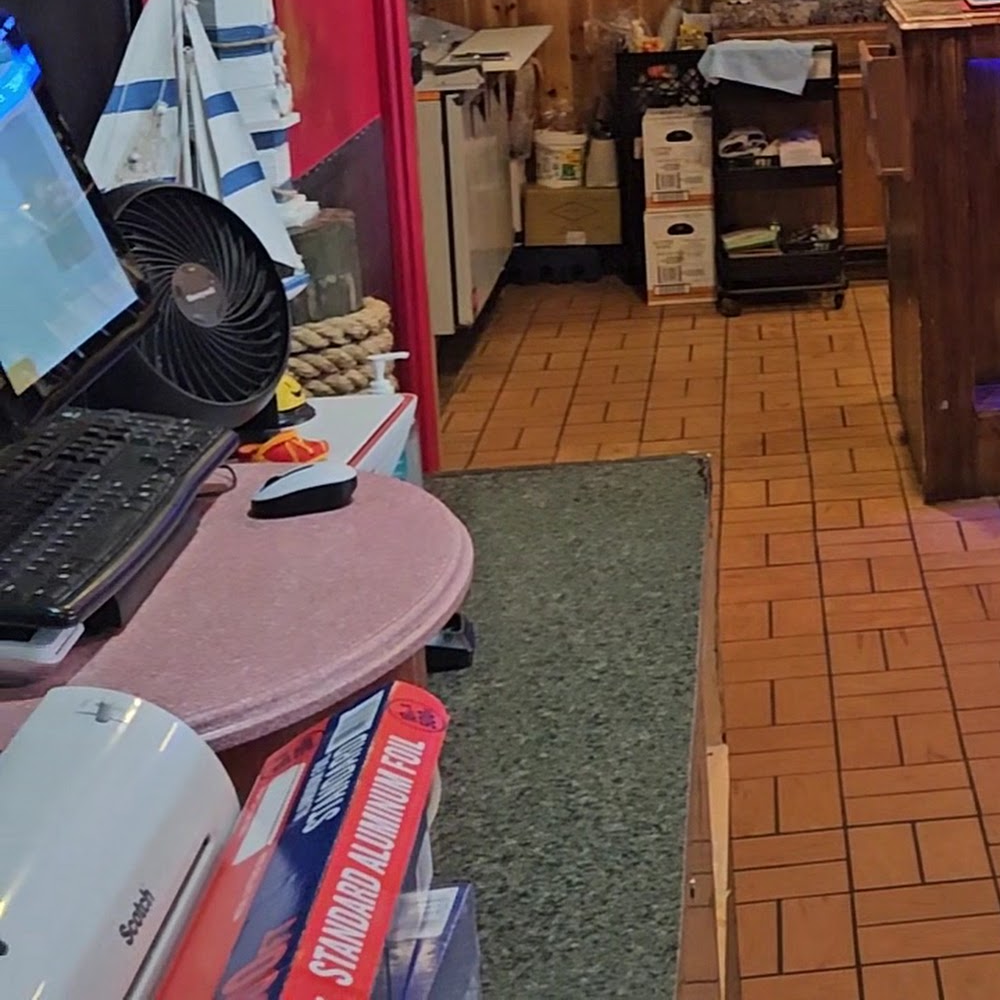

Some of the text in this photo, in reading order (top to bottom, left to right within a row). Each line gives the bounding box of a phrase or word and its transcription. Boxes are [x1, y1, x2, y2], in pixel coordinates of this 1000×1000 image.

[302, 733, 368, 834] STANDARD
[309, 866, 382, 987] STANDARD
[347, 767, 417, 876] ALUMINUM
[384, 734, 426, 776] FOIL
[119, 888, 156, 946] Scotch
